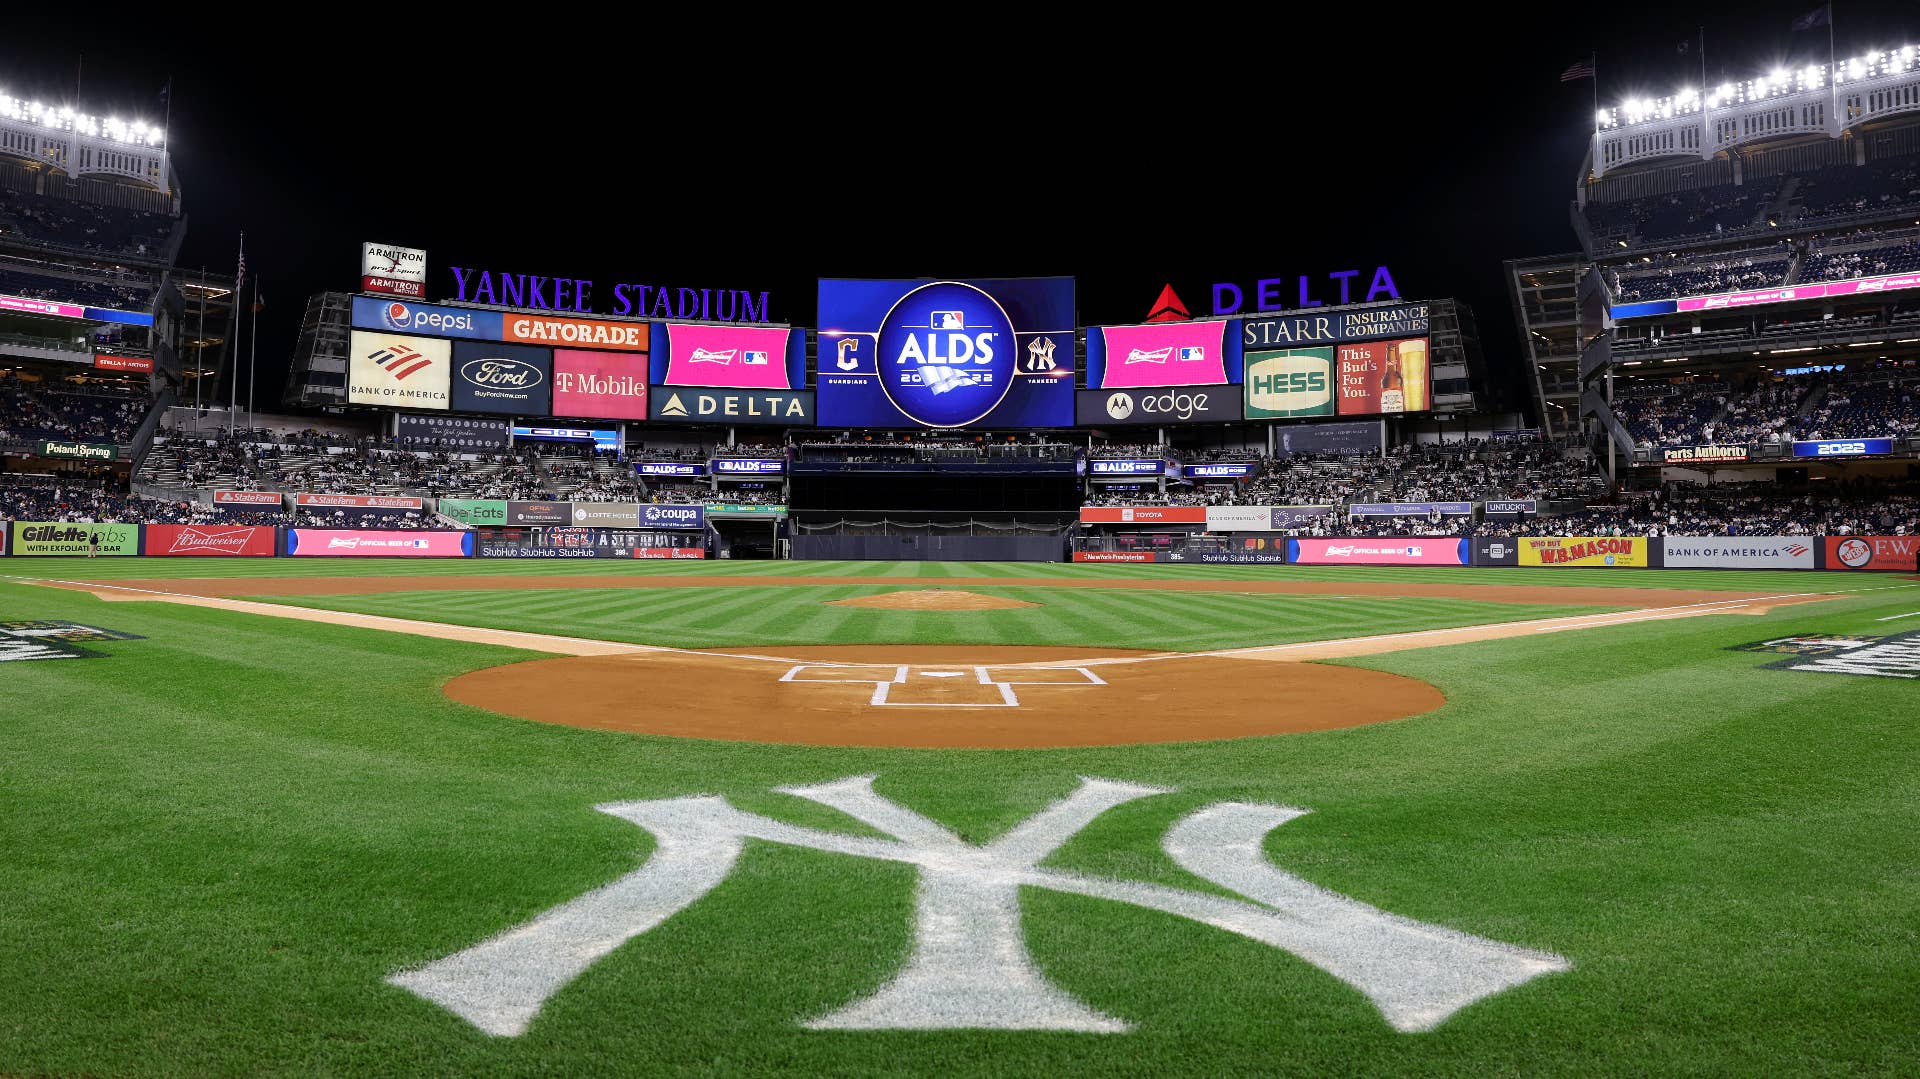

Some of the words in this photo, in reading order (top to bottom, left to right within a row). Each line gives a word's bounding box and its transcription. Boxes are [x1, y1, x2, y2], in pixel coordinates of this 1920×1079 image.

[368, 247, 423, 262] ARMITRON
[370, 278, 419, 291] ARMITRON
[1212, 265, 1399, 315] DELTA
[449, 266, 593, 313] YANKEE
[613, 283, 770, 322] STADIUM
[1345, 306, 1429, 326] INSURANCE
[513, 319, 639, 346] GATORADE
[1244, 317, 1335, 345] STARR
[1345, 319, 1429, 338] COMPANIES
[897, 332, 994, 364] ALDS
[1341, 347, 1371, 360] This
[1342, 360, 1377, 373] Bud's
[475, 361, 529, 386] Ford
[1342, 375, 1365, 385] For
[577, 373, 645, 397] Mobile
[1253, 371, 1326, 395] HESS
[351, 386, 381, 395] BANK
[383, 388, 397, 396] OF
[399, 389, 447, 400] AMERICA
[1342, 386, 1370, 398] You.
[698, 395, 804, 417] DELTA
[1142, 389, 1209, 420] edge
[46, 443, 79, 454] Poland
[80, 444, 111, 458] Spring
[1664, 449, 1693, 459] Parts
[1695, 445, 1747, 458] Authority
[1818, 442, 1865, 454] 2022
[654, 465, 676, 473] ALDS
[732, 461, 760, 470] ALDS
[1107, 462, 1135, 472] ALDS
[1206, 467, 1229, 475] ALDS
[474, 506, 504, 519] Eats
[661, 509, 697, 522] coupa
[22, 526, 87, 541] Gillette
[178, 533, 247, 546] Budweiser
[1530, 540, 1546, 548] WHO
[483, 547, 517, 557] StubHub
[520, 548, 556, 557] StubHub
[558, 548, 595, 557] StubHub
[1202, 554, 1228, 562] StubHub
[1668, 548, 1700, 557] BANK
[1703, 548, 1719, 557] OF
[1722, 548, 1779, 557] AMERICA
